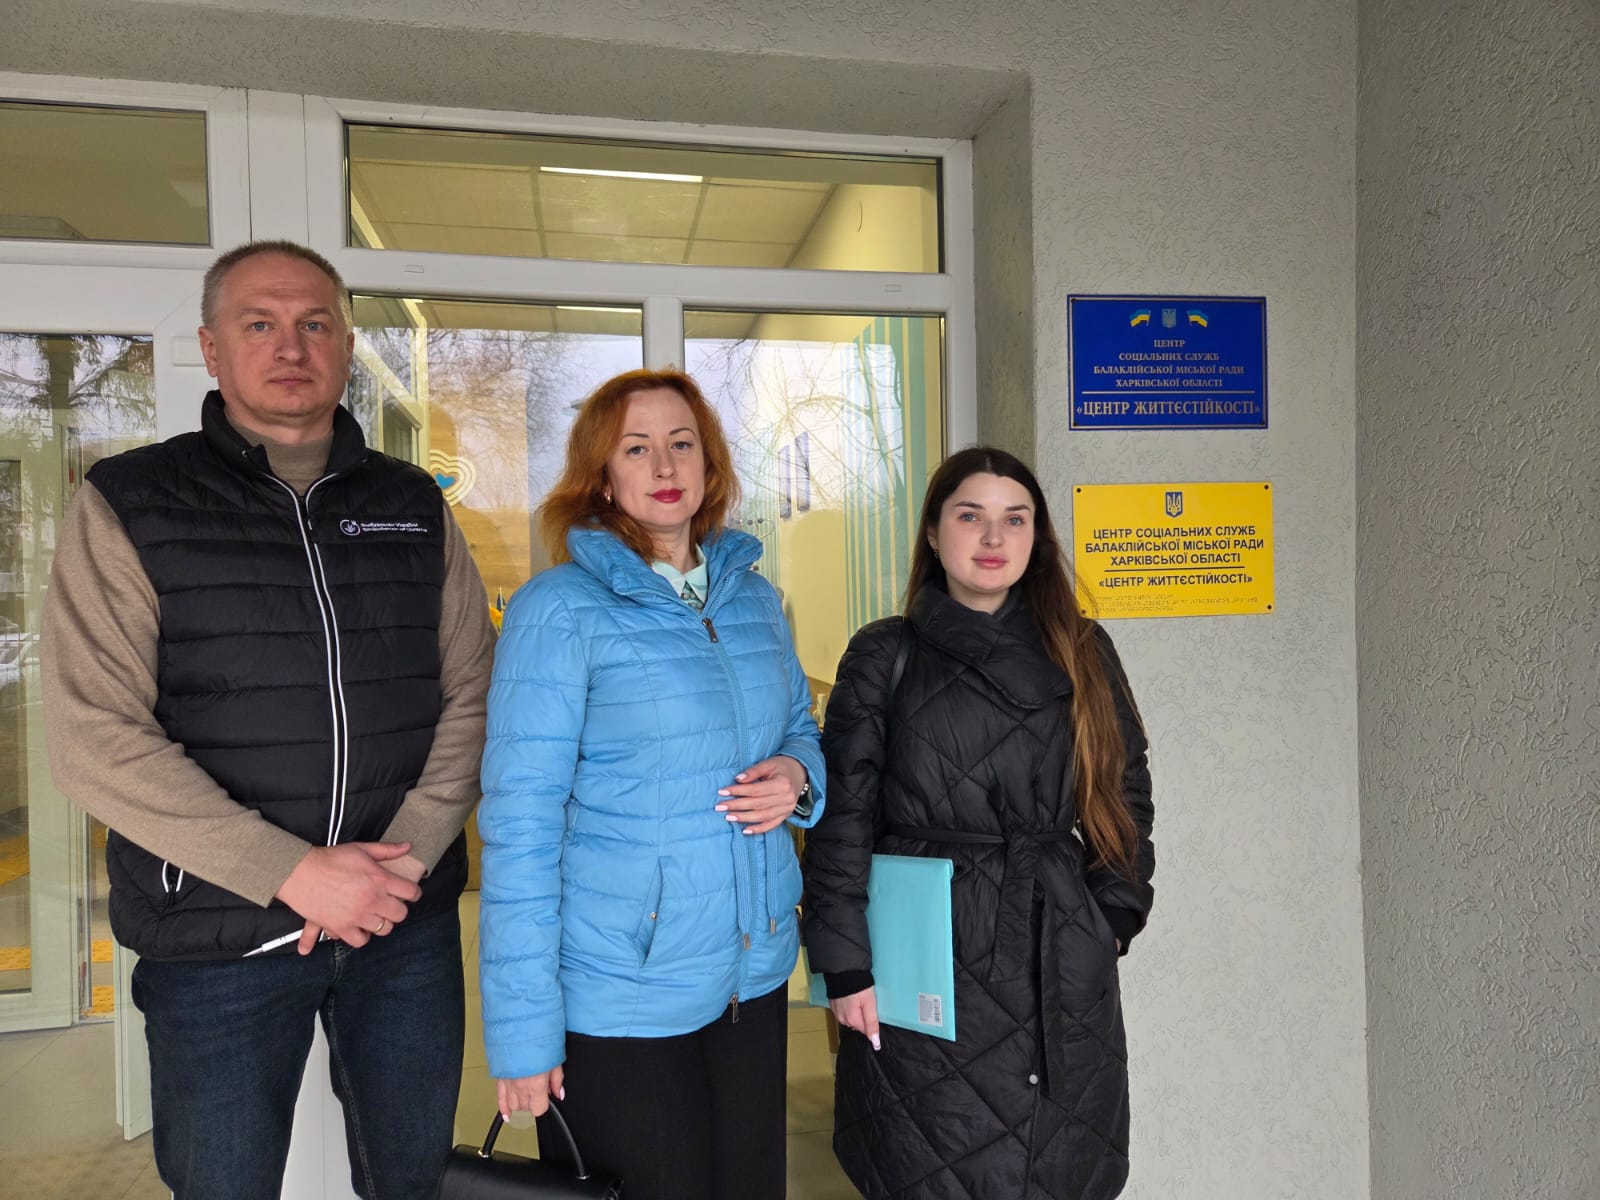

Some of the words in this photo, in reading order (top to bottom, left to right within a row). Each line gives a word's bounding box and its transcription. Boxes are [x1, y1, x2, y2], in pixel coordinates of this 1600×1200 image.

[1154, 340, 1185, 349] ЦЕНТР
[1119, 353, 1182, 362] СОЦІАЛЬНИХ
[1184, 353, 1219, 361] СЛУЖБ
[1094, 365, 1173, 374] БАЛАКЛІЙСЬКОЇ
[1176, 365, 1216, 374] МІСЬКОЇ
[1219, 367, 1244, 375] РАДИ
[1116, 378, 1179, 387] ХАРКІВСЬКОЇ
[1182, 379, 1222, 387] ОБЛАСТІ
[1077, 401, 1129, 417] «ЦЕНТР
[1134, 398, 1260, 415] ЖИТТЄСТІЙКОСТІ»
[1093, 528, 1133, 540] ЦЕНТР
[1136, 527, 1212, 539] СОЦІАЛЬНИХ
[1215, 526, 1256, 536] СЛУЖБ
[1085, 539, 1180, 553] БАЛАКЛІЙСЬКОЇ
[1183, 539, 1230, 550] МІСЬКОЇ
[1234, 539, 1264, 550] РАДИ
[1111, 553, 1188, 566] ХАРКІВСЬКОЇ
[1191, 553, 1241, 563] ОБЛАСТІ
[1099, 577, 1143, 588] «ЦЕНТР
[1147, 572, 1253, 586] ЖИТТЄСТІЙКОСТІ»
